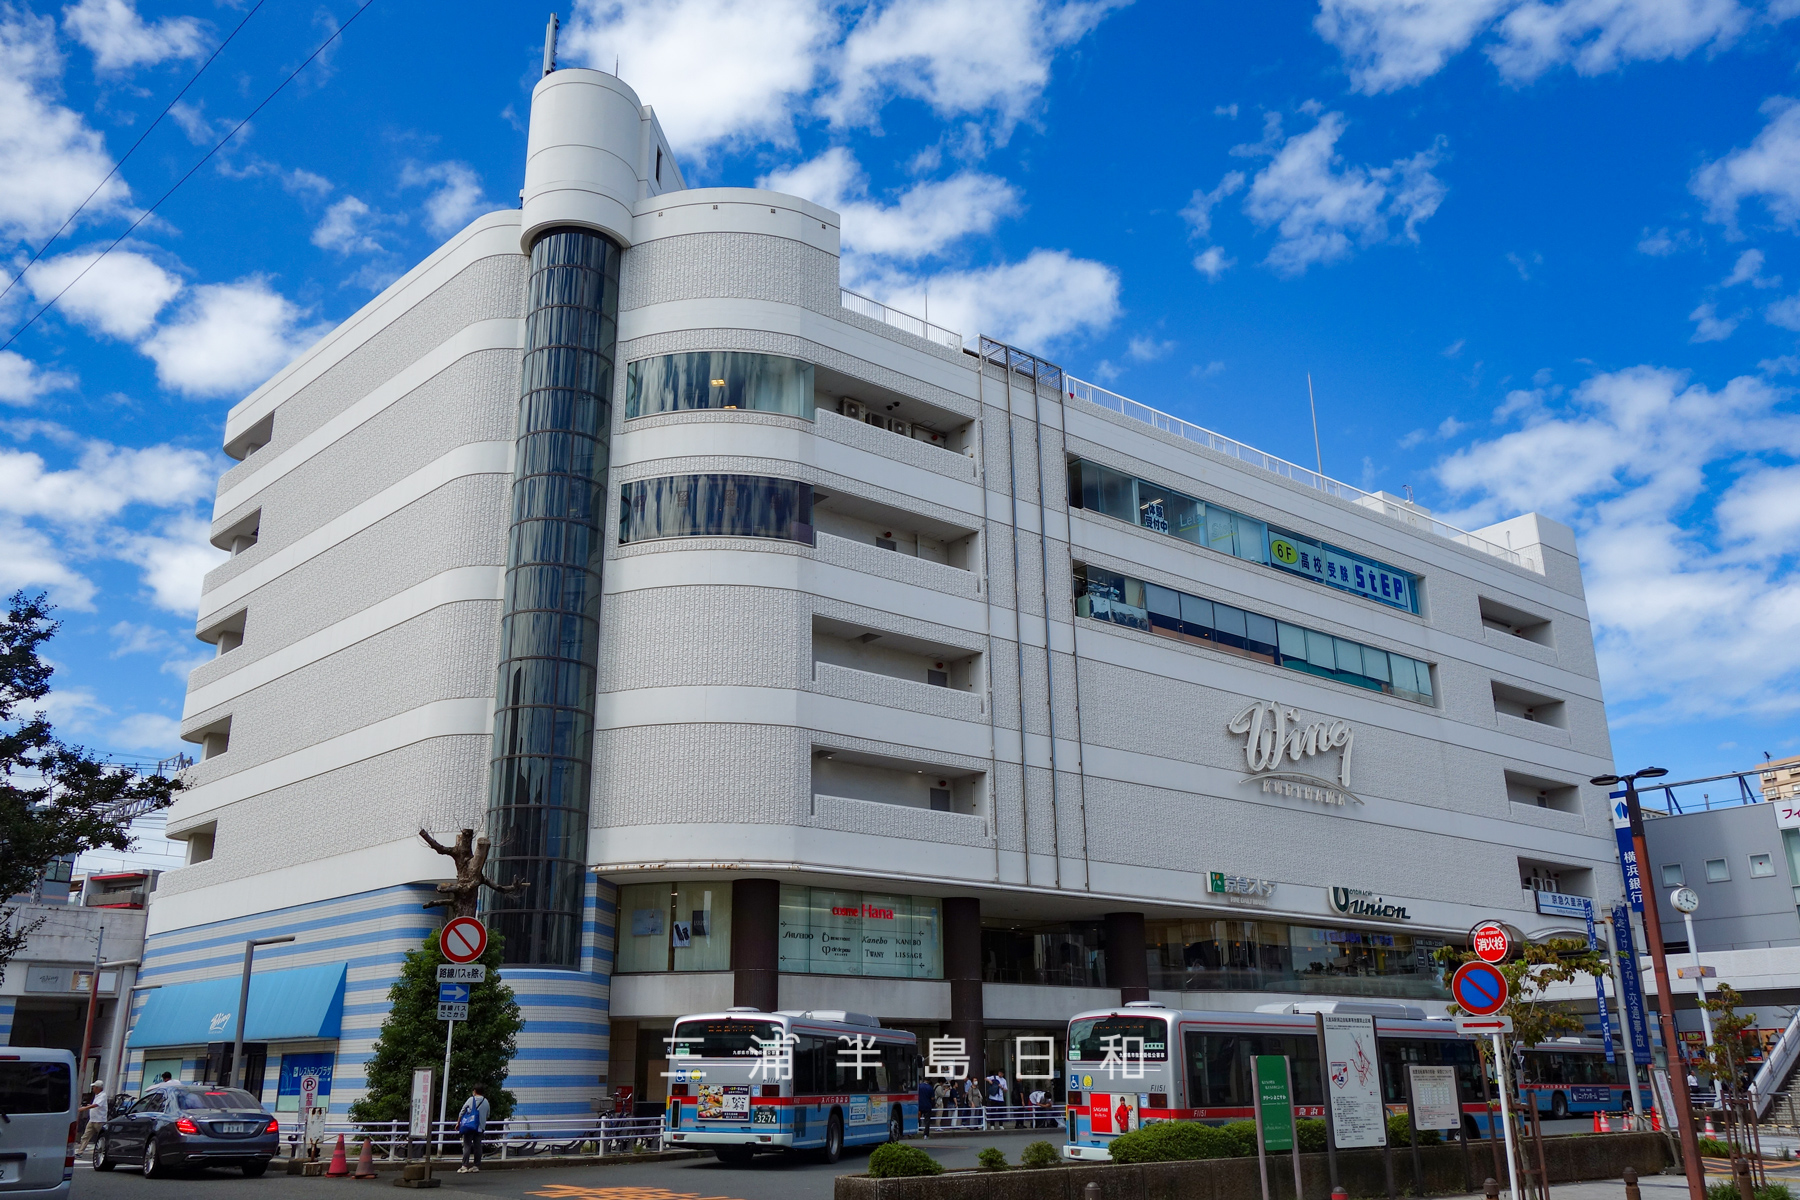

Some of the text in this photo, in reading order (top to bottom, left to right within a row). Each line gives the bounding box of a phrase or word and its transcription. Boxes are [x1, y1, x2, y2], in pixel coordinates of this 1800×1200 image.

[1148, 502, 1164, 518] 体験
[1145, 515, 1168, 534] 受付中
[1277, 543, 1292, 560] 6F
[1300, 551, 1349, 583] 高校受験
[1228, 700, 1354, 788] Wing
[1262, 779, 1347, 806] KURIHAMA
[1623, 851, 1643, 904] 横浜銀行
[1225, 875, 1278, 898] 京急ストア
[1551, 895, 1588, 908] 京急久里浜
[832, 903, 894, 919] cosme Hana
[782, 931, 814, 940] SHISEIDO
[861, 936, 888, 945] Kanebo
[895, 938, 922, 946] KANEBO
[1476, 936, 1505, 952] 消火栓
[894, 951, 923, 960] LISSAGE
[439, 968, 484, 979] 路線バスを除く
[299, 1066, 333, 1076] レストランプラザ
[757, 1115, 776, 1123] 32-74
